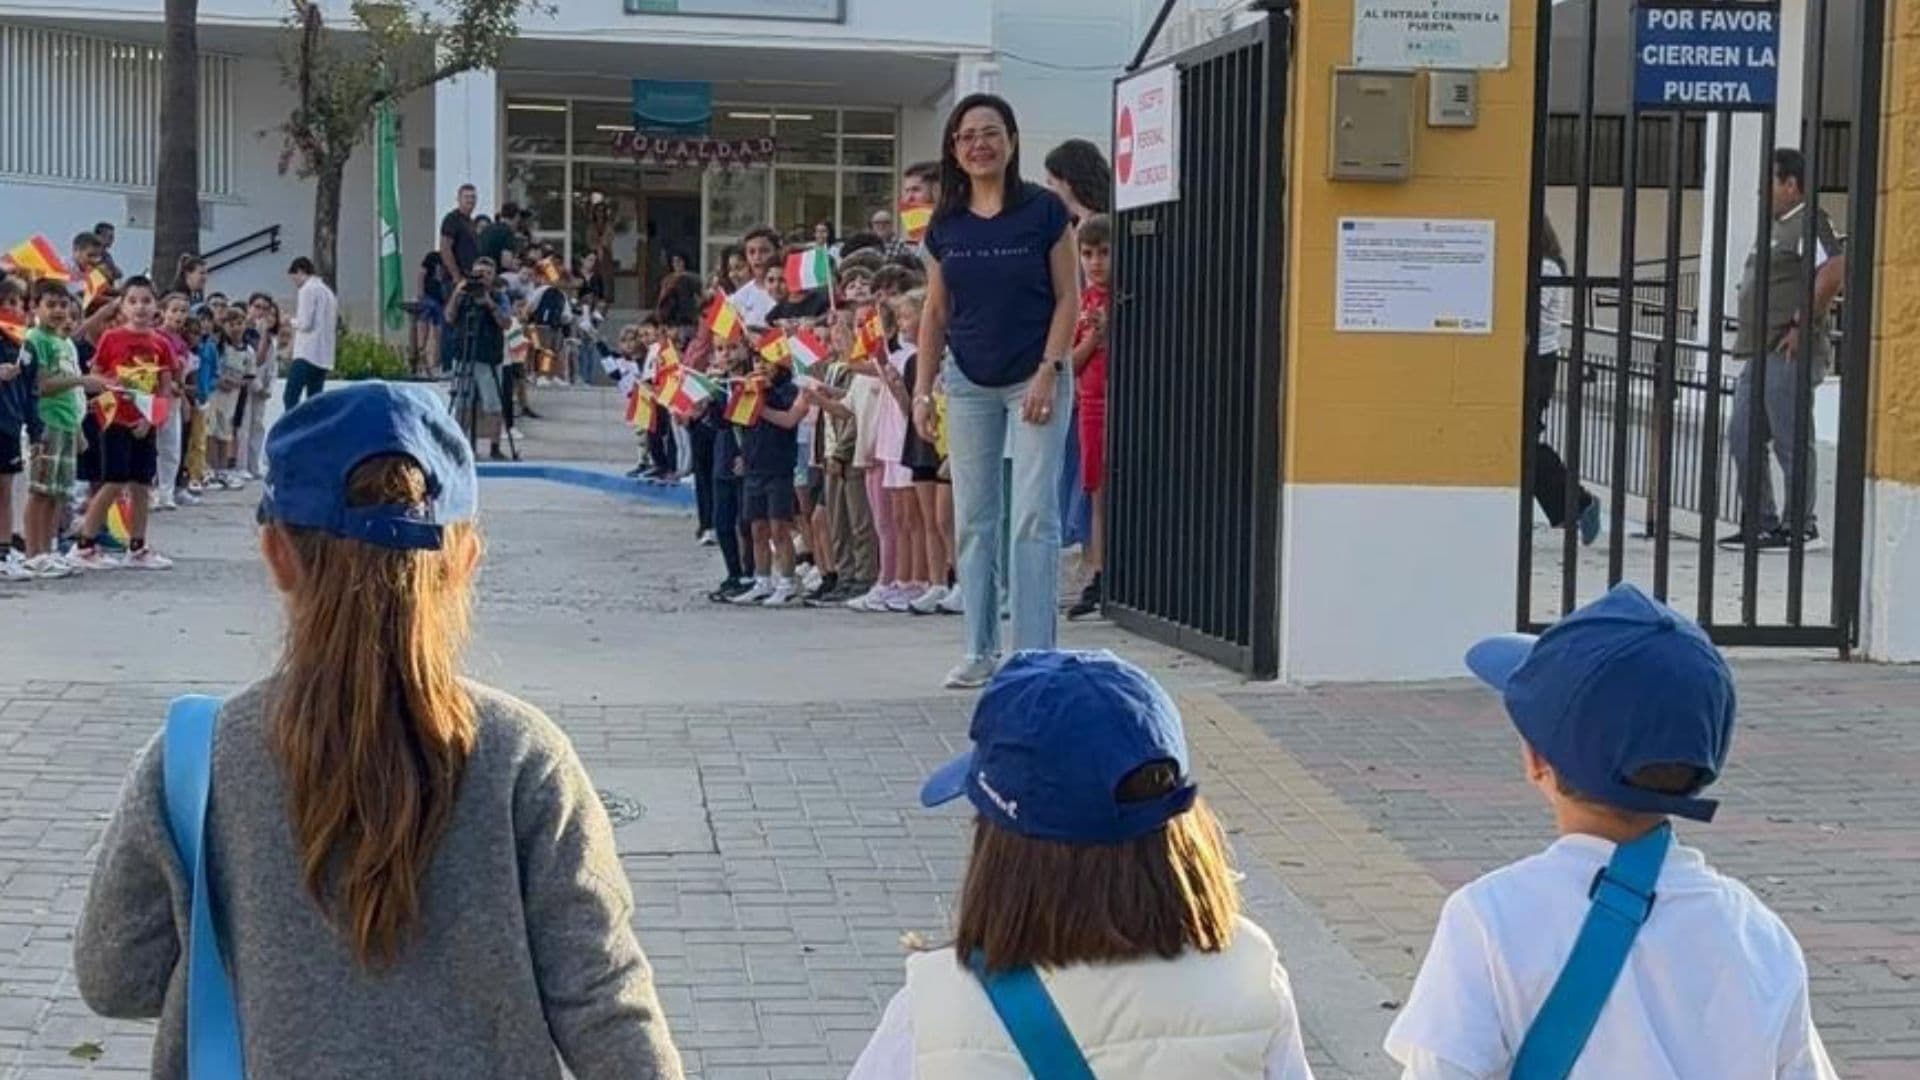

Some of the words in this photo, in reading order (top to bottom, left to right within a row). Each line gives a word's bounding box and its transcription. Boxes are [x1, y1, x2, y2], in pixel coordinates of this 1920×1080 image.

[1363, 9, 1380, 19] AL
[1382, 10, 1429, 20] ENTRAR
[1484, 12, 1499, 23] LA
[1648, 8, 1694, 30] POR
[1701, 9, 1772, 31] FAVOR
[1642, 45, 1740, 67] CIERREN
[1746, 46, 1776, 67] LA
[1663, 80, 1751, 102] PUERTA
